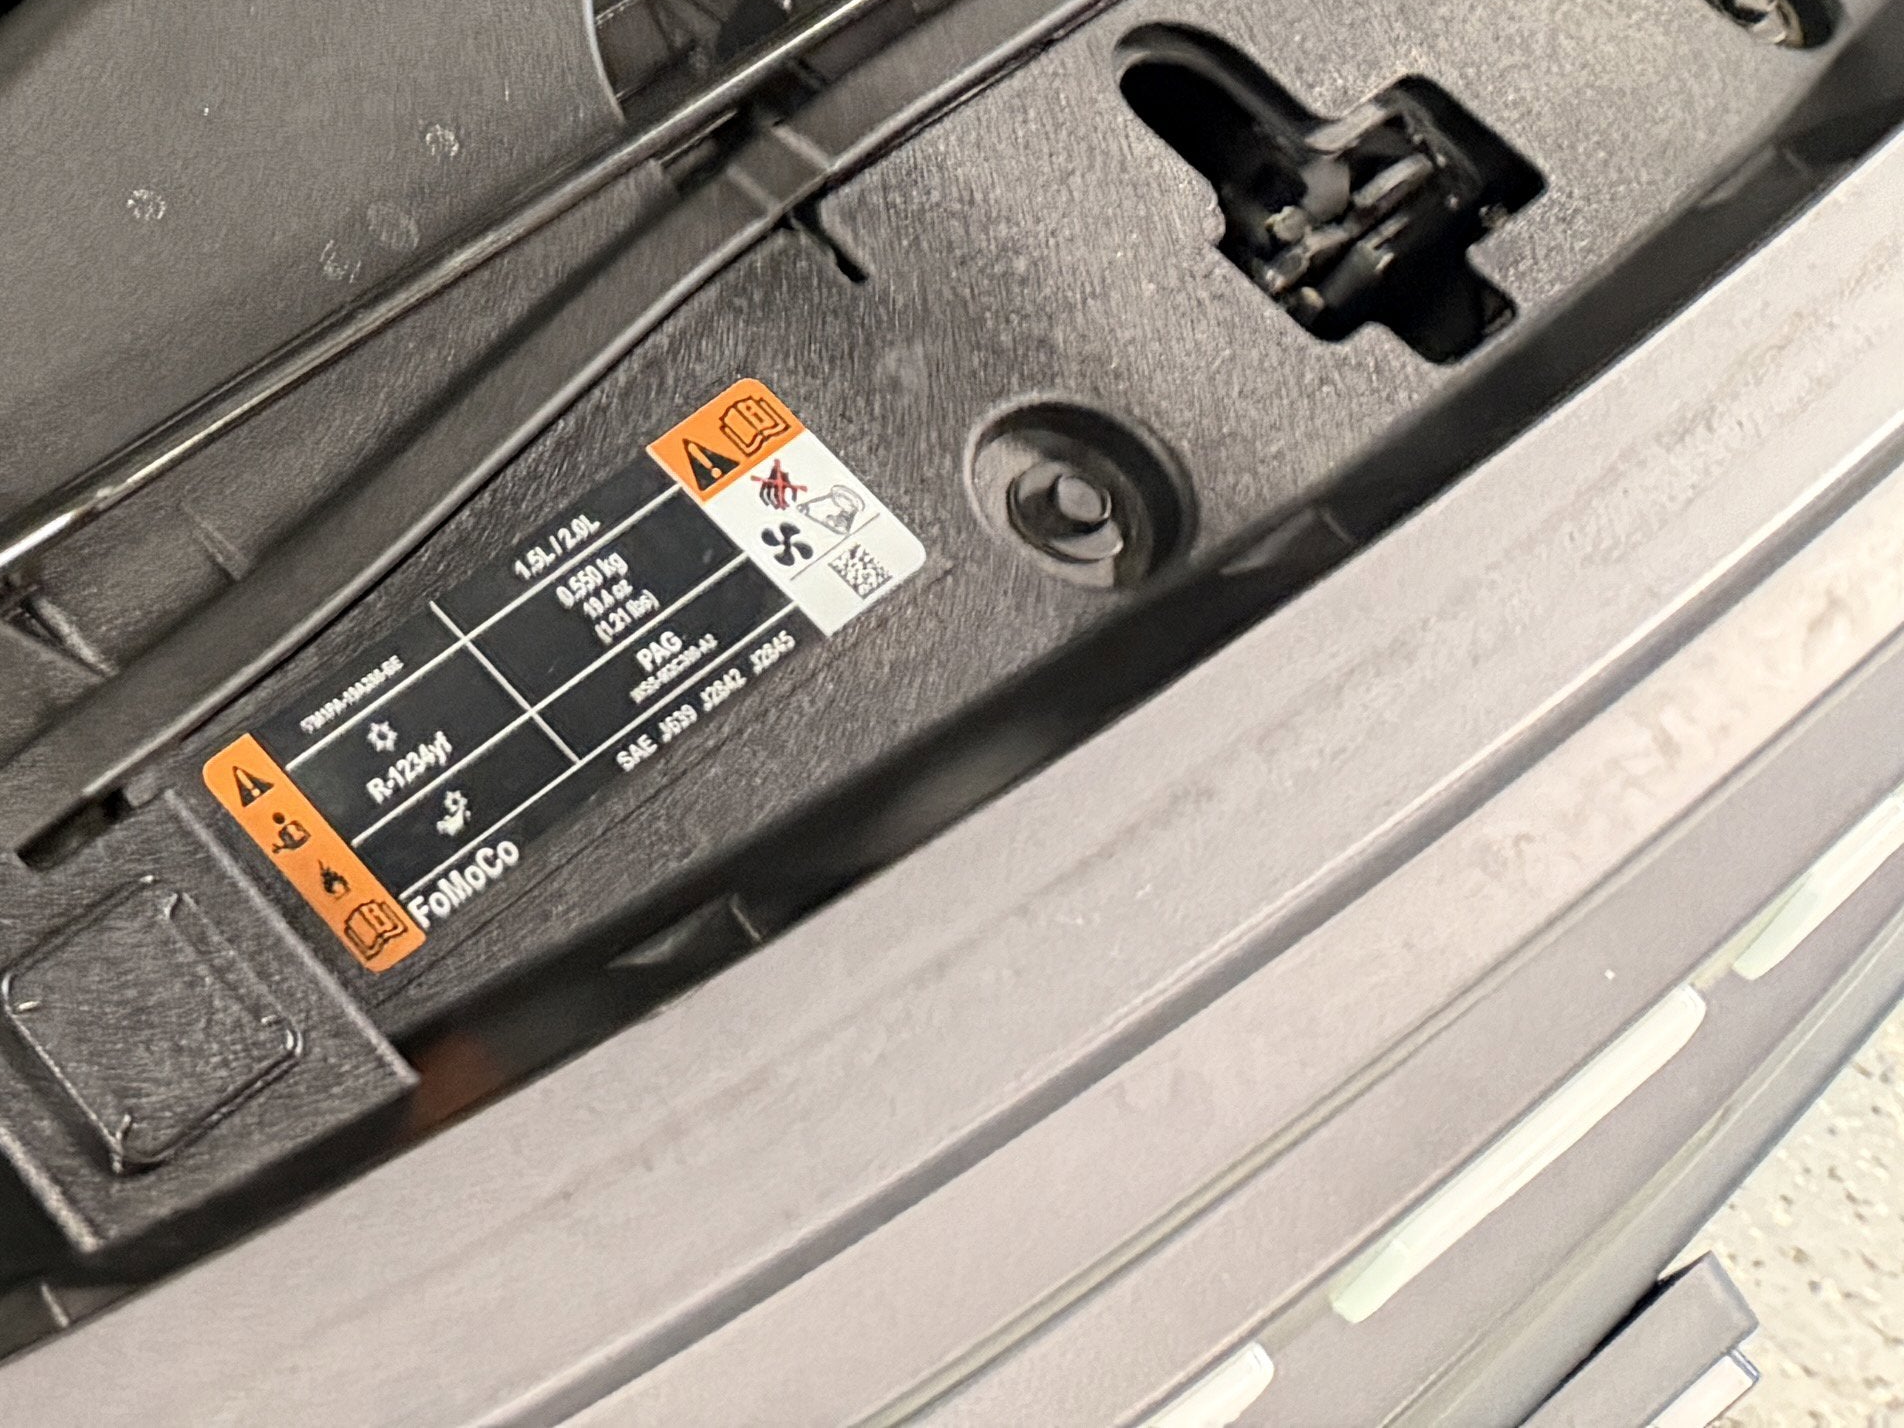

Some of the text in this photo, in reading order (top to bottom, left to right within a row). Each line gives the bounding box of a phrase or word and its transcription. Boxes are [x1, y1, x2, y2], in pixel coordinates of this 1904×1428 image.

[555, 552, 629, 610] 0.550 kg
[635, 631, 684, 673] PAG
[365, 730, 453, 804] R-1234yf
[615, 734, 659, 772] SAE
[658, 704, 698, 743] J639
[407, 841, 520, 928] FoMoCo
